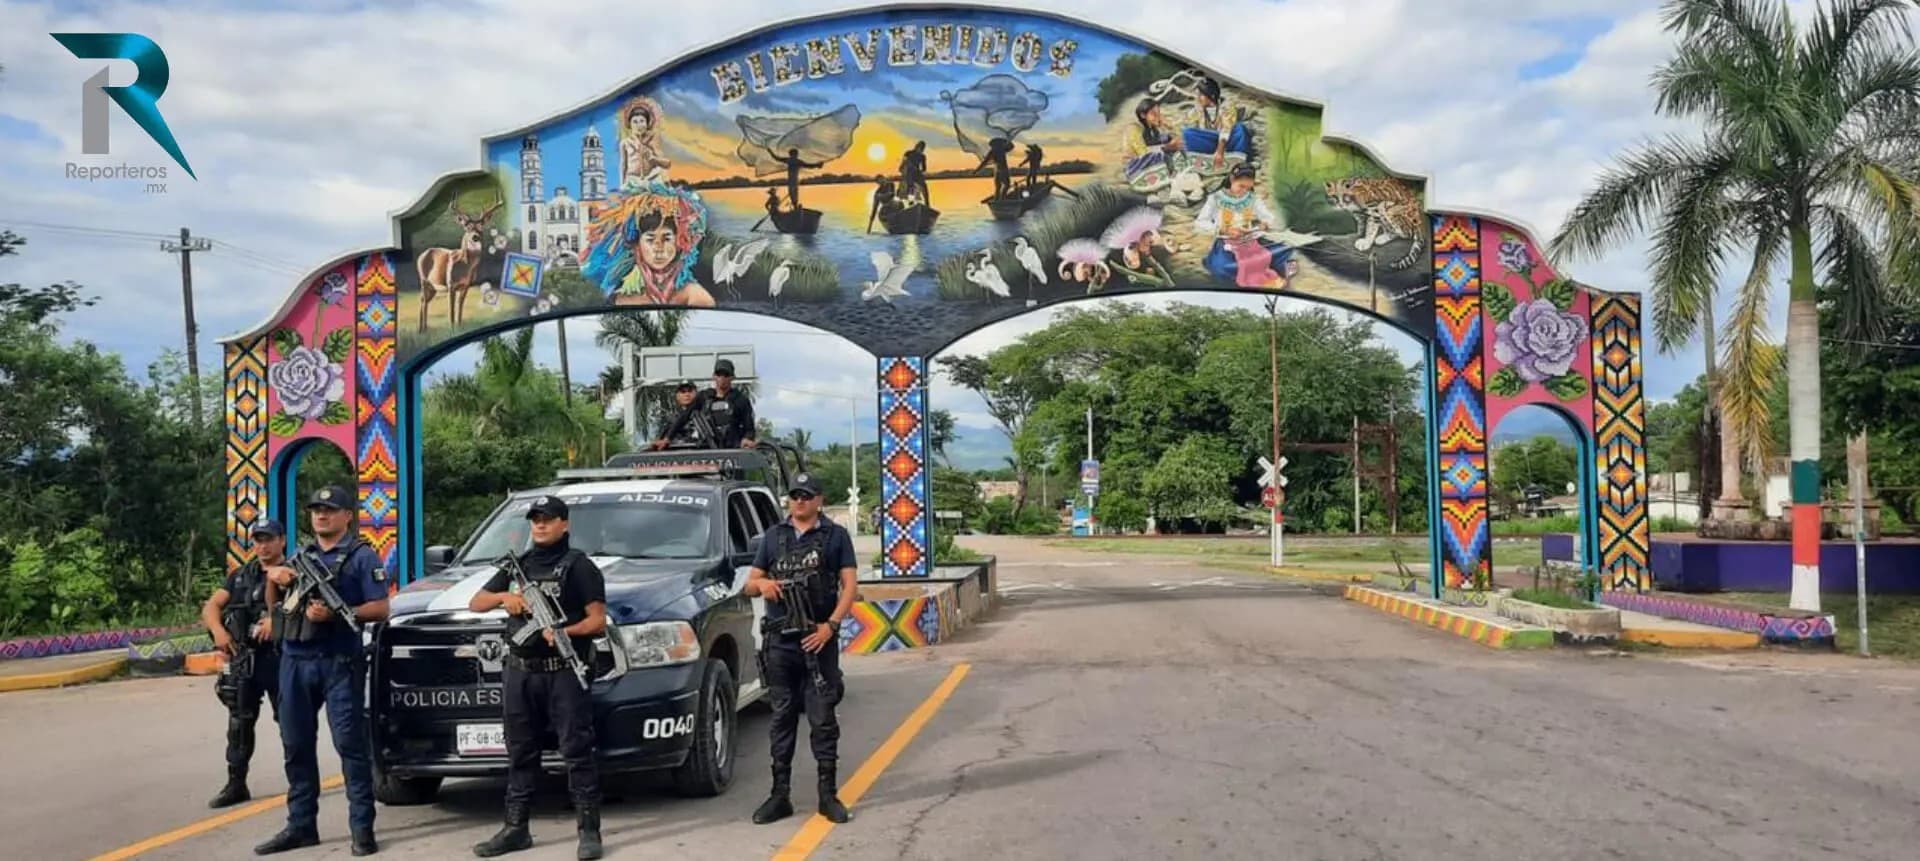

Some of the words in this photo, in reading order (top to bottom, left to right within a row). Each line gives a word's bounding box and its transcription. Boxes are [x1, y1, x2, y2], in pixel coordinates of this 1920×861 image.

[711, 23, 1079, 104] BIENVENIDOS
[390, 690, 471, 707] POLICIA
[643, 714, 694, 739] 0040
